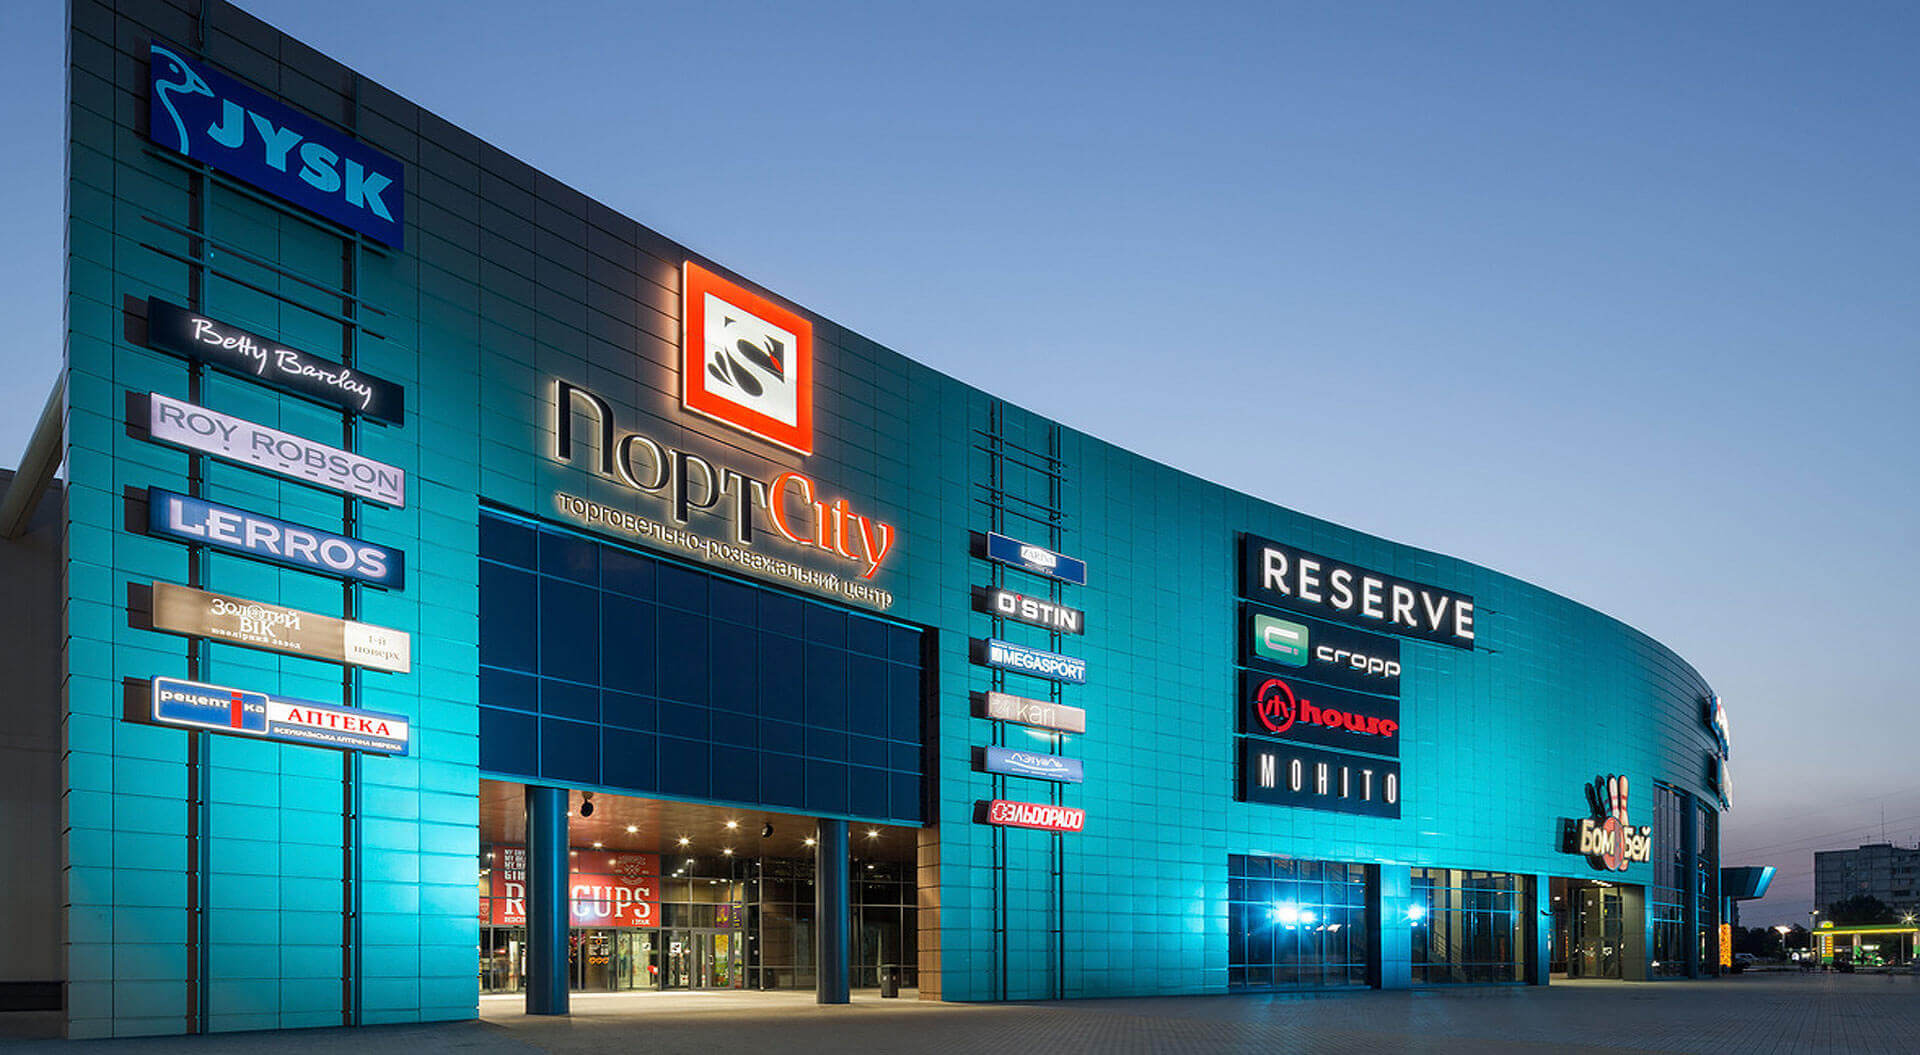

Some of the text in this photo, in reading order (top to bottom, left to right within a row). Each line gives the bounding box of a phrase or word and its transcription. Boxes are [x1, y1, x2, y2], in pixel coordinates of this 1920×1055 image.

[207, 99, 394, 222] JYSK
[192, 318, 372, 410] Betty Barclay
[159, 402, 398, 492] ROY ROBSON
[169, 498, 388, 578] LERROS
[558, 492, 893, 610] торговельно-розважальний центр
[1263, 547, 1475, 640] RESERVE
[1003, 648, 1085, 680] MEGASPORT
[1316, 645, 1401, 678] cropp
[287, 708, 390, 736] АПТЕКА
[1300, 699, 1399, 737] house
[1261, 754, 1397, 804] MOHITO
[571, 884, 651, 918] CUPS
